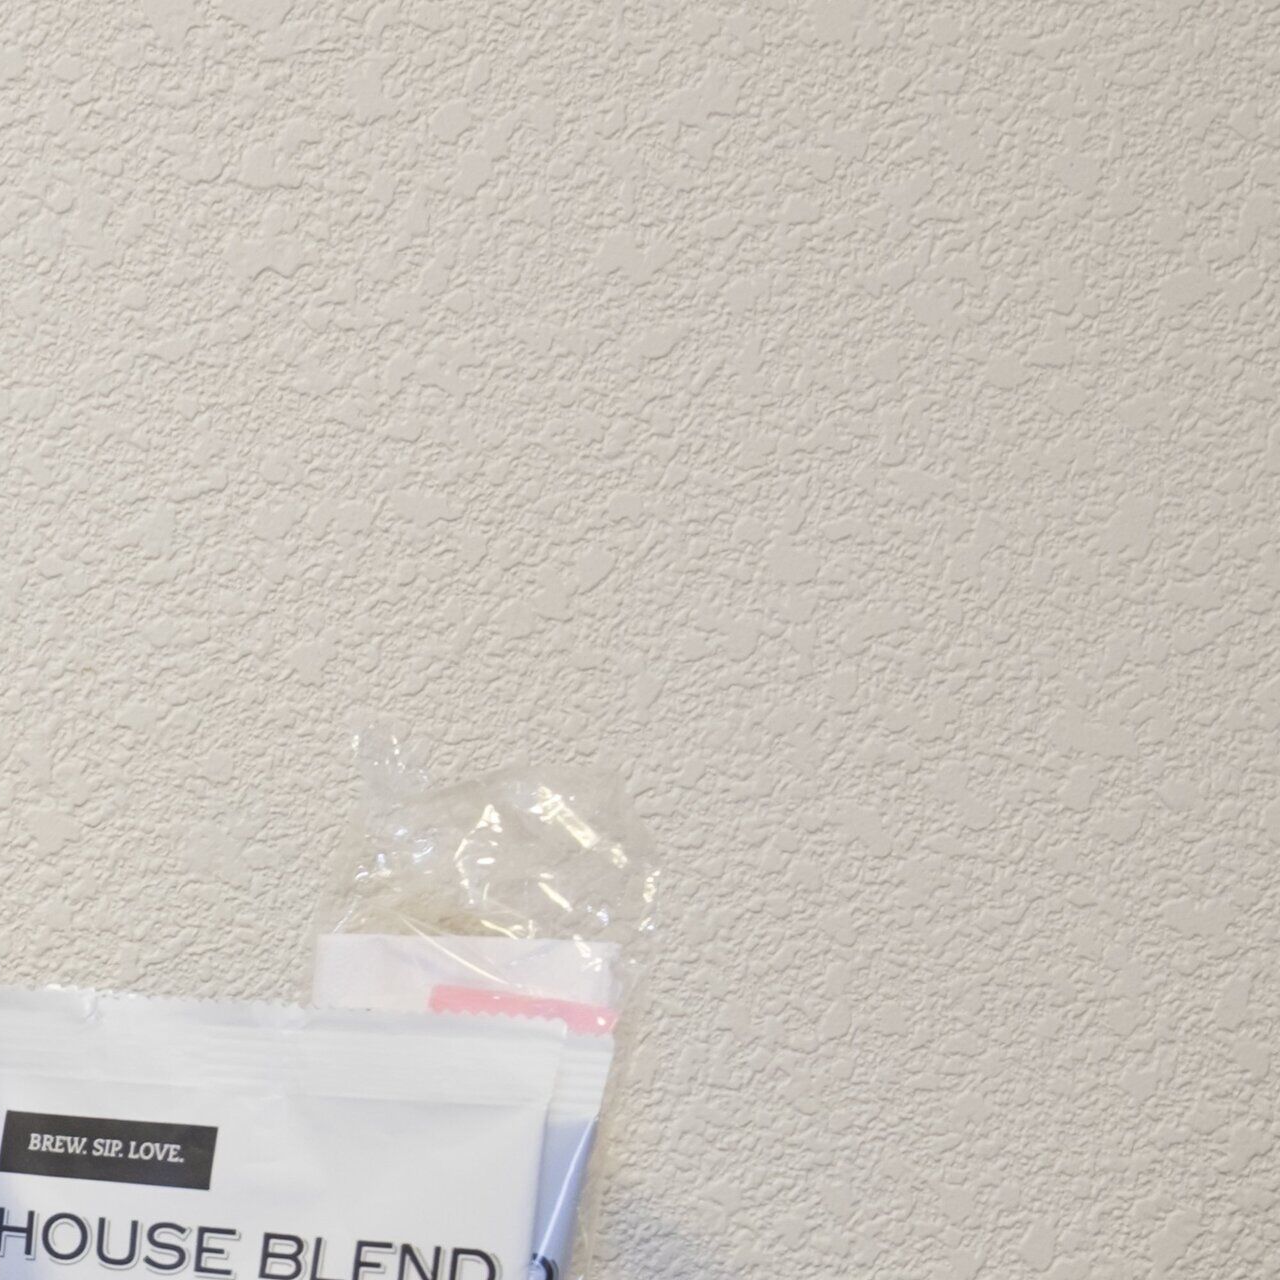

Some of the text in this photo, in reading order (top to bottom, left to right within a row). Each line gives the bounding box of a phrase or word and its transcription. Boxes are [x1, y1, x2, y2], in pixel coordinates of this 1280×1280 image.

[28, 1133, 185, 1162] BREW. SIP. LOVE.
